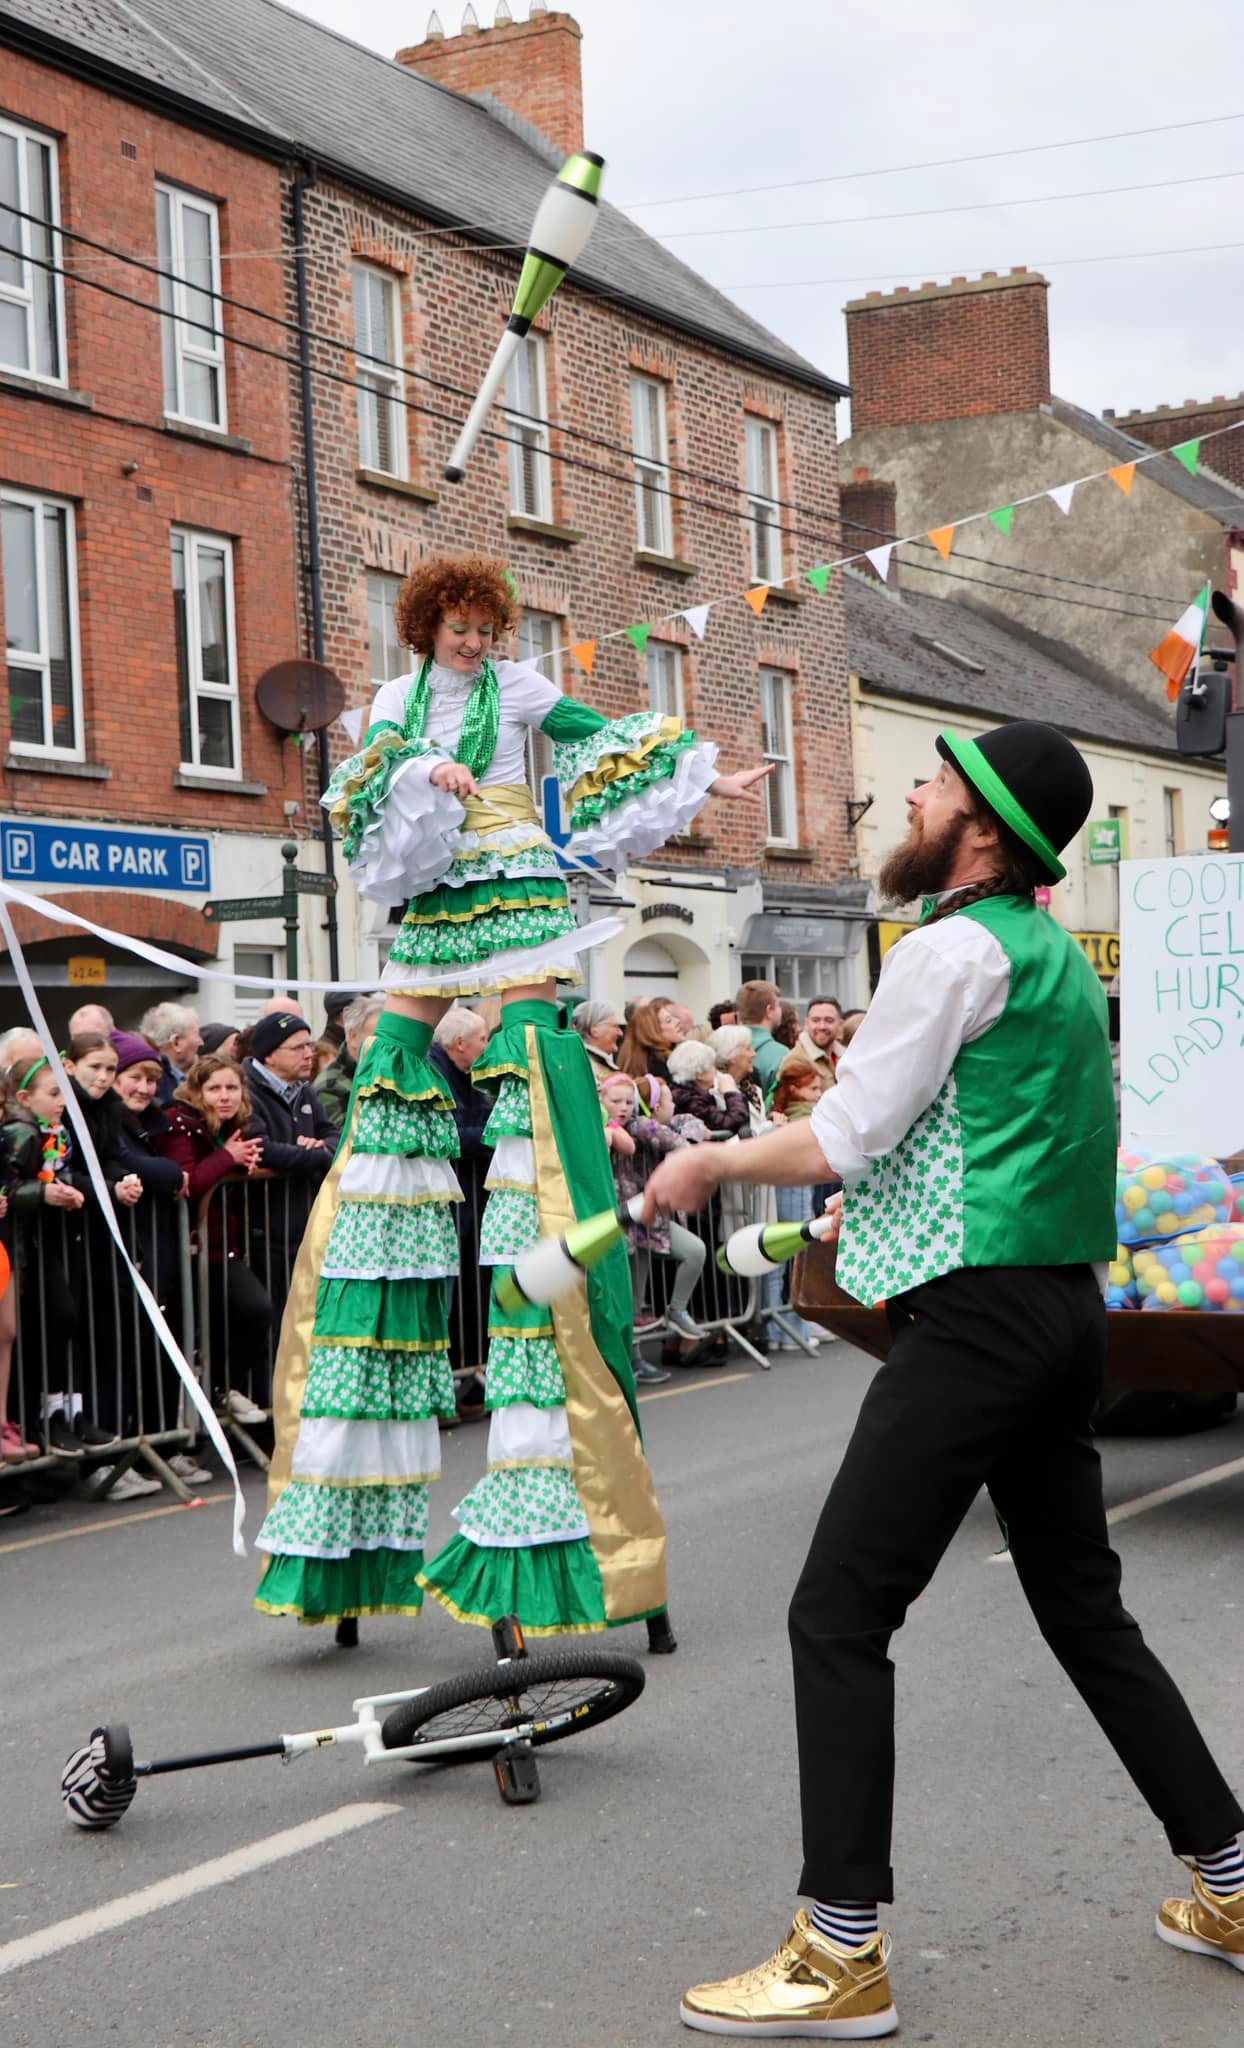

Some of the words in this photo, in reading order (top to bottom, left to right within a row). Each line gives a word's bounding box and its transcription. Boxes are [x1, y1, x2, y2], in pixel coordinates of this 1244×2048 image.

[12, 837, 29, 867] P
[50, 840, 101, 871] CAR
[107, 844, 168, 876] PARK
[184, 850, 201, 879] P
[1133, 861, 1244, 912] COOT
[1164, 911, 1244, 957] CEL
